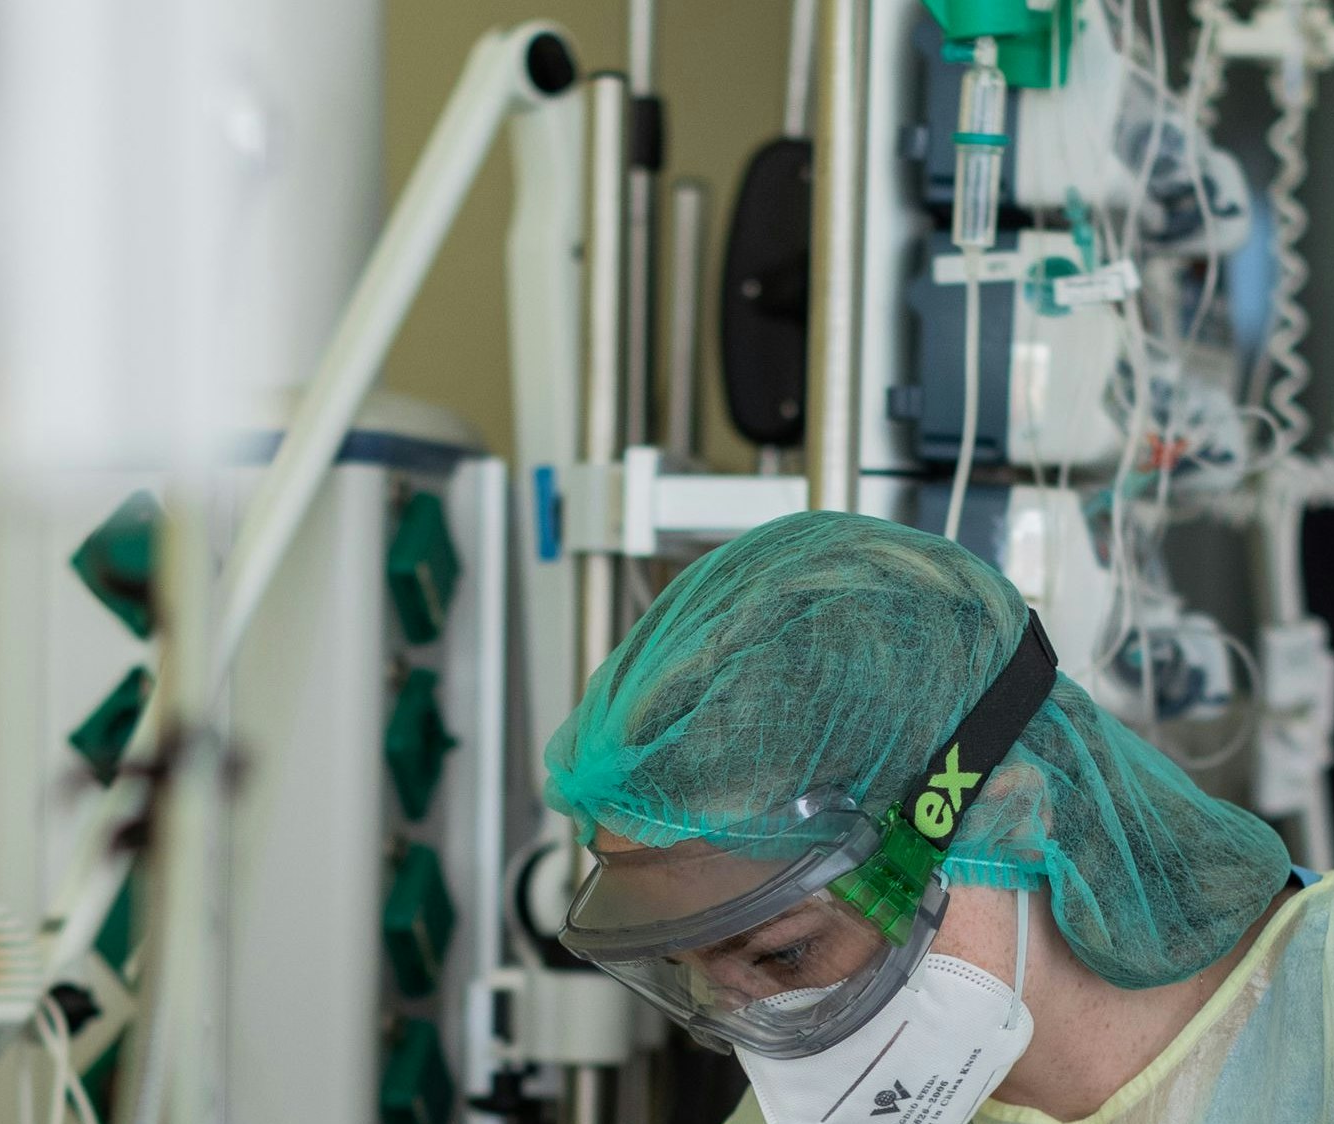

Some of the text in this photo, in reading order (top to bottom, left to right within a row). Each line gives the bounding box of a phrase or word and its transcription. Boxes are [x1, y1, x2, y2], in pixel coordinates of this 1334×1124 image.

[916, 1075, 939, 1100] WEIDA
[931, 1110, 943, 1120] in
[940, 1079, 963, 1107] China
